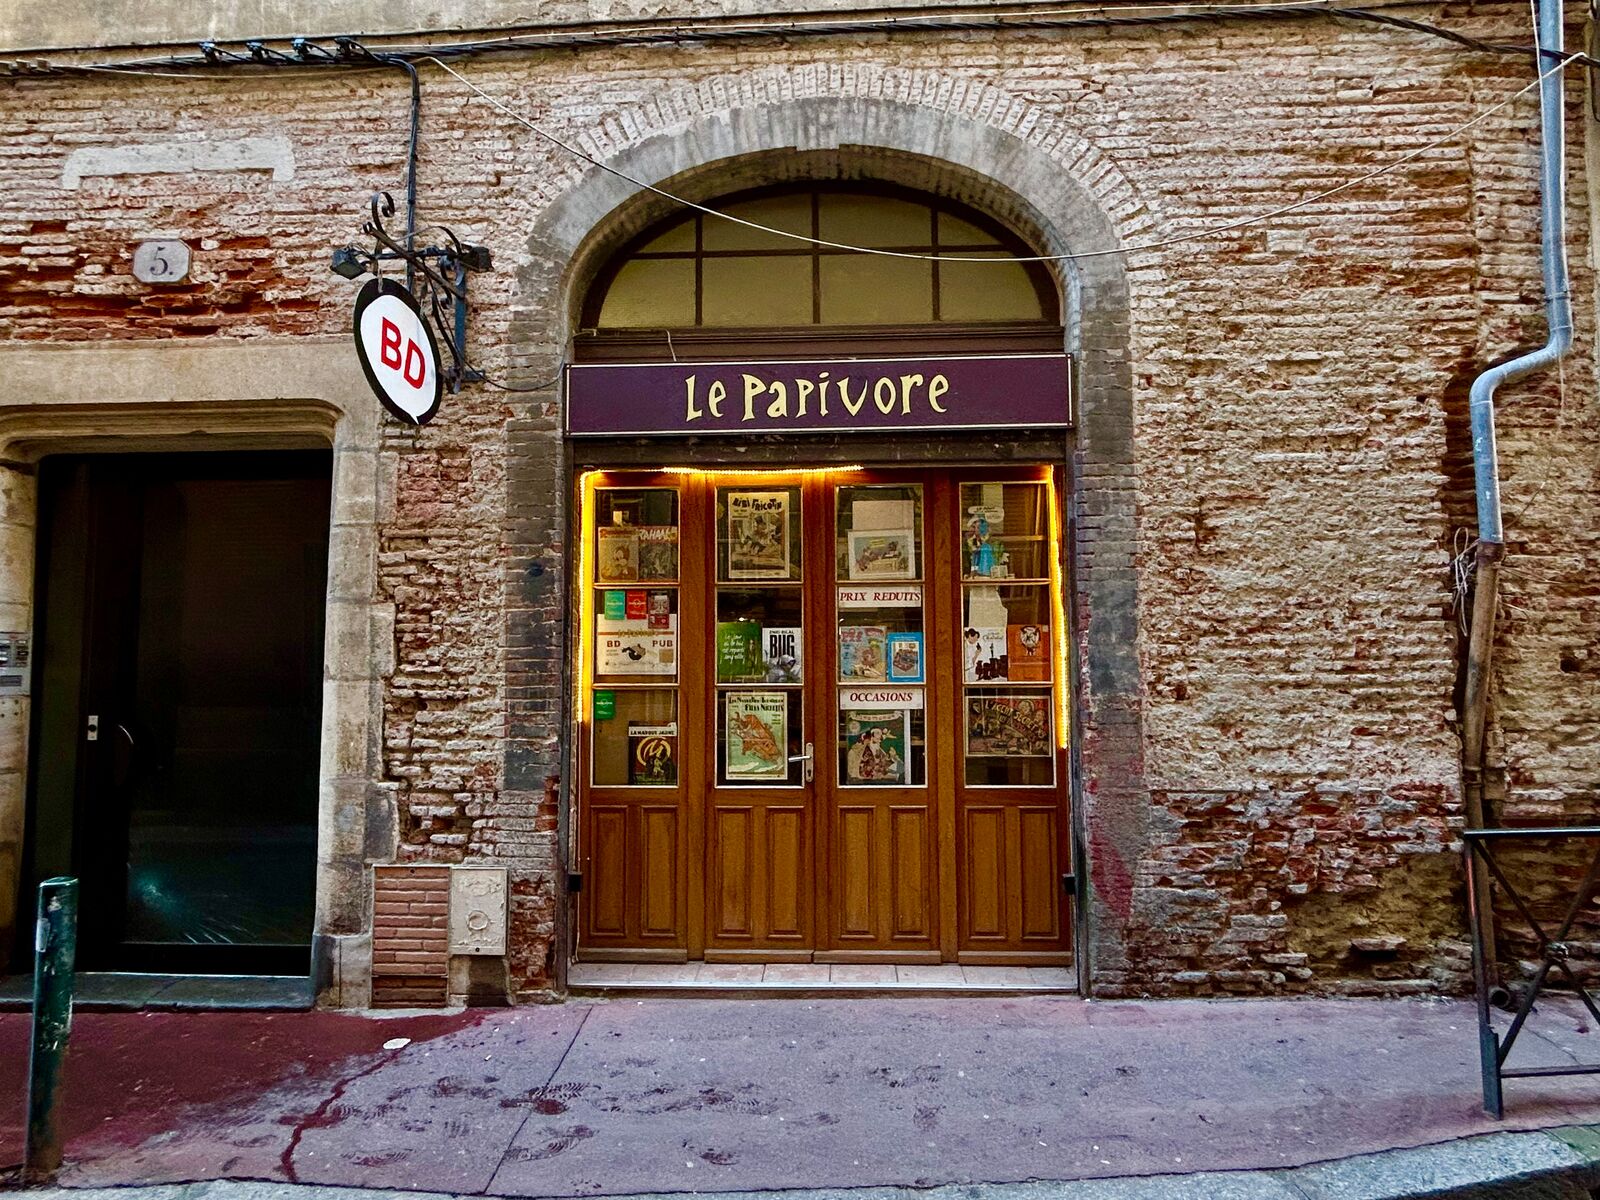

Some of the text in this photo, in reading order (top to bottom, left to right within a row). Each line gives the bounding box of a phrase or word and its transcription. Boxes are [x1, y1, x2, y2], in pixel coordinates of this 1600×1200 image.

[380, 316, 426, 390] BD
[685, 371, 950, 422] Le Papivore
[840, 592, 921, 601] PRIX REDUITS
[606, 640, 673, 648] BD PUB
[769, 634, 795, 659] BUG
[849, 692, 913, 702] OCCASIONS
